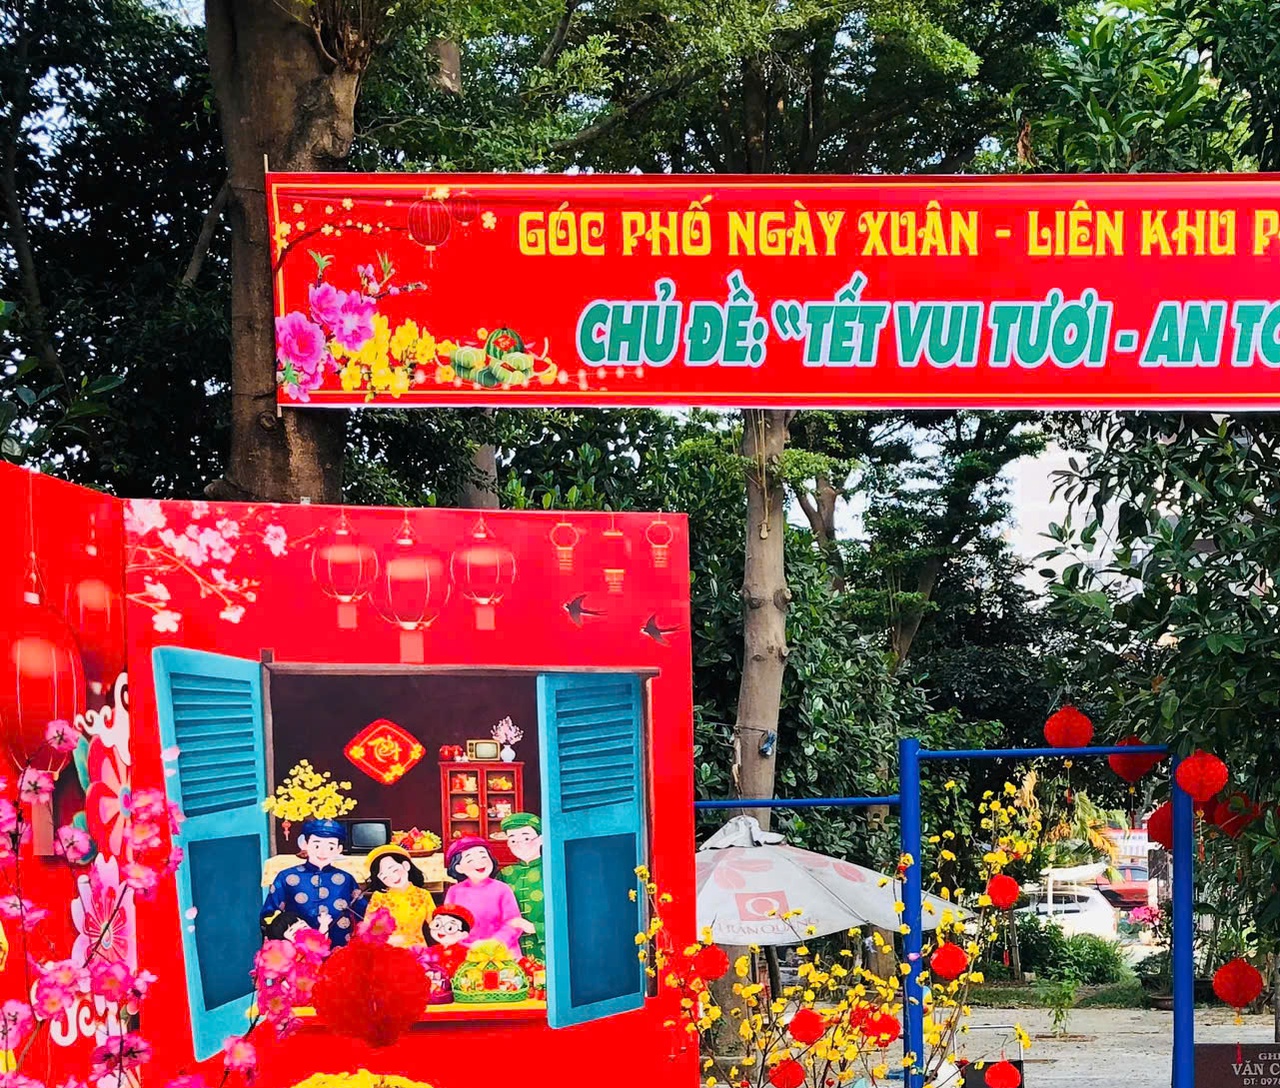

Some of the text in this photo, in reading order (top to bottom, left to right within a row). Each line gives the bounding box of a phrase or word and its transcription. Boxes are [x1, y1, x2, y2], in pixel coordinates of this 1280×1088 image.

[518, 200, 606, 256] GÓC
[620, 193, 713, 256] PHỐ
[728, 200, 844, 256] NGÀY
[859, 200, 979, 256] XUÂN
[995, 229, 1011, 238] -
[1027, 200, 1124, 256] LIÊN
[1141, 209, 1236, 256] KHU
[576, 278, 683, 367] CHỦ
[684, 270, 770, 367] ĐỀ:
[771, 271, 892, 367] “TẾT
[893, 301, 985, 368] VUI
[988, 288, 1113, 368] TƯƠI
[1115, 330, 1138, 352] -
[1139, 301, 1228, 368] AN
[1231, 1060, 1264, 1075] VĂN
